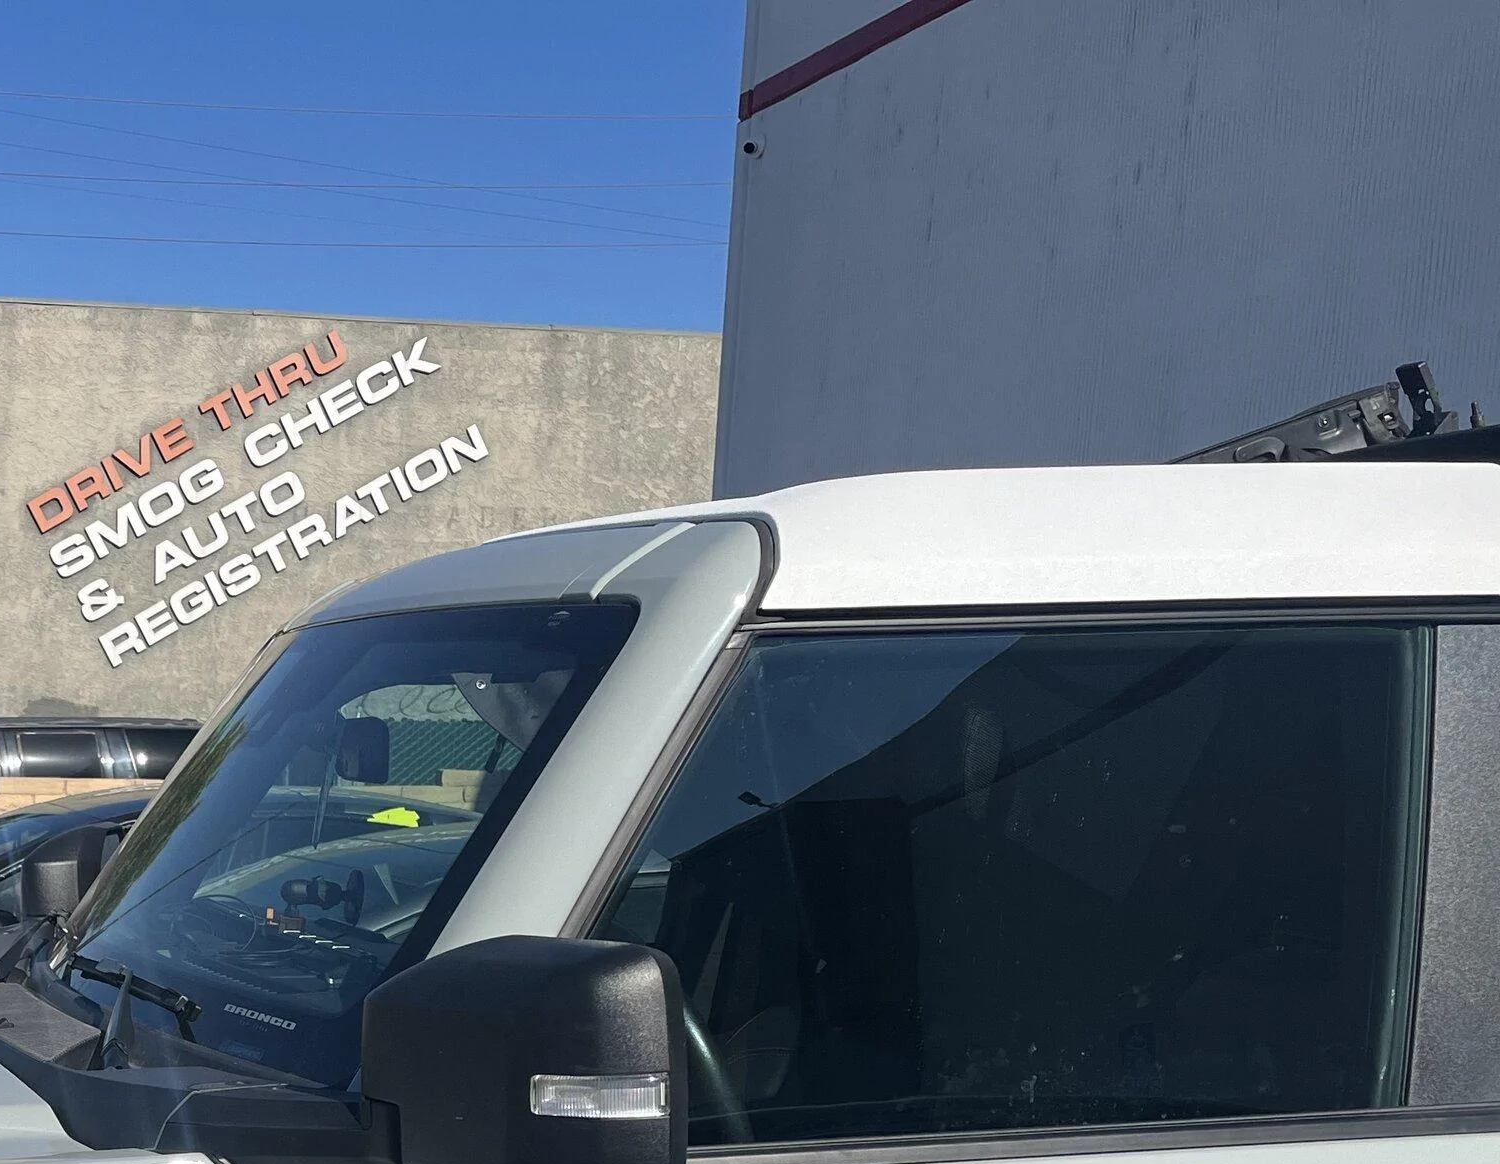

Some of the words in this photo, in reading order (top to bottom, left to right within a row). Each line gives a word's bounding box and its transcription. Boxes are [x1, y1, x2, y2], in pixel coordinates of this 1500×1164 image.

[27, 417, 195, 533] DRIVE
[199, 330, 349, 430] THRU
[49, 458, 225, 578] SMOG
[244, 336, 442, 467] CHECK
[77, 578, 125, 622] &
[154, 470, 306, 584] AUTO
[98, 424, 490, 667] REGISTRATION
[223, 1003, 297, 1031] BRONCO
